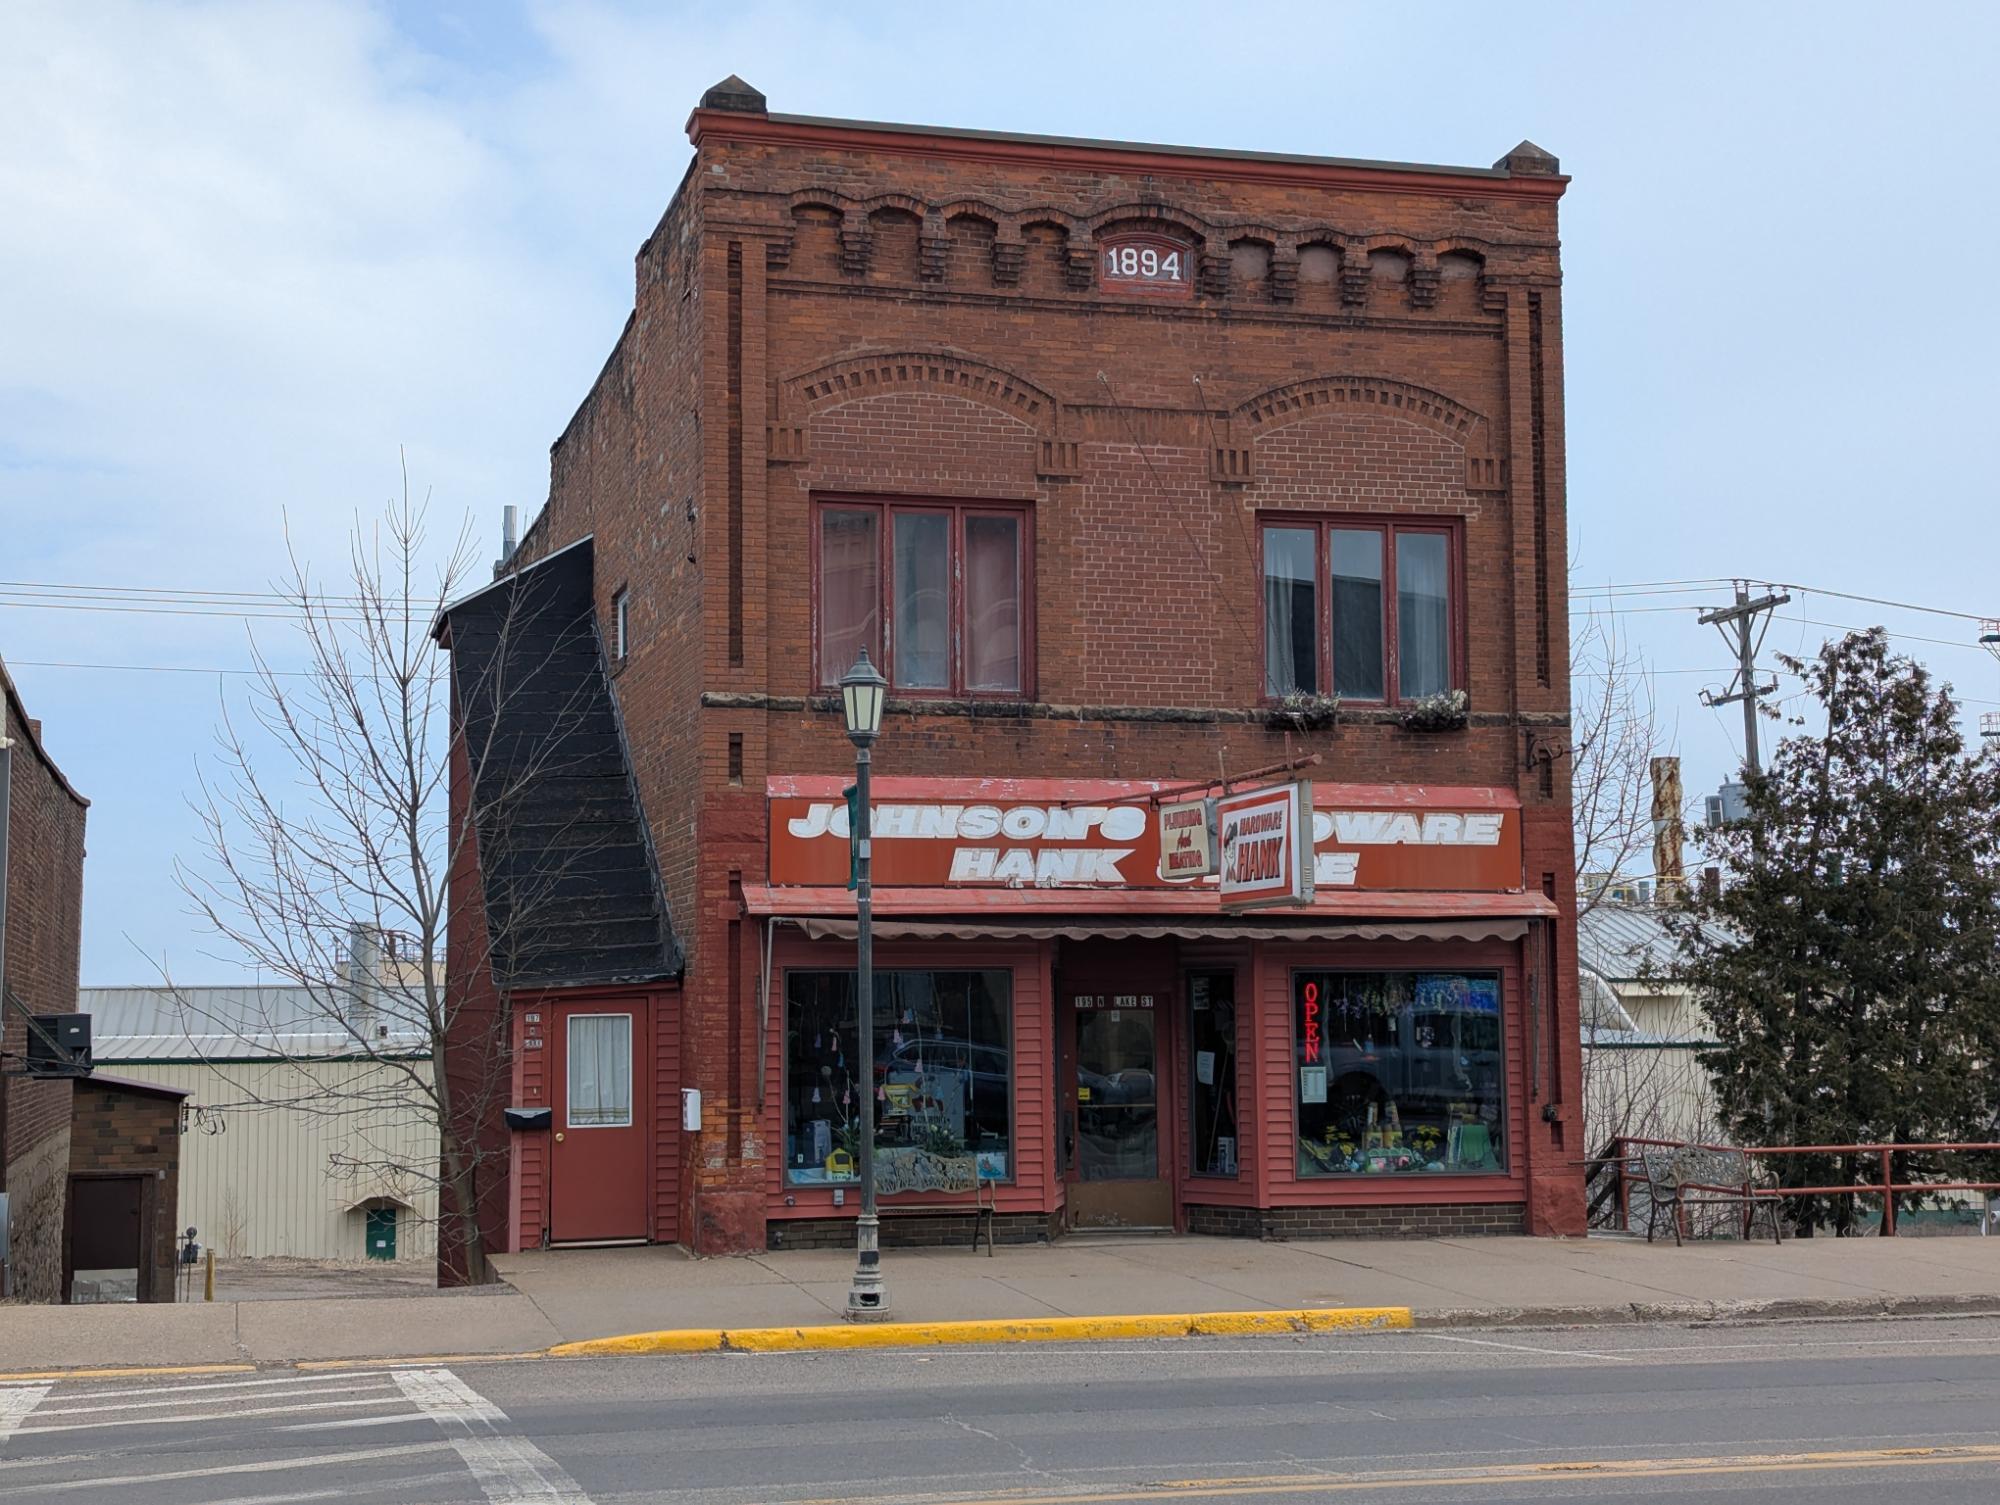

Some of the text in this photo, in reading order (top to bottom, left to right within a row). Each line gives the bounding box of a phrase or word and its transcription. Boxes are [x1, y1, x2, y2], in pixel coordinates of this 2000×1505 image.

[1108, 247, 1180, 280] 1894
[788, 803, 1146, 840] JOHNSON'S
[1239, 810, 1283, 837] HARDWARE
[948, 848, 1136, 883] HANK
[1236, 836, 1284, 884] HANK
[1114, 996, 1136, 1007] LAKE
[1142, 996, 1153, 1007] ST
[1305, 983, 1319, 1063] OPEN
